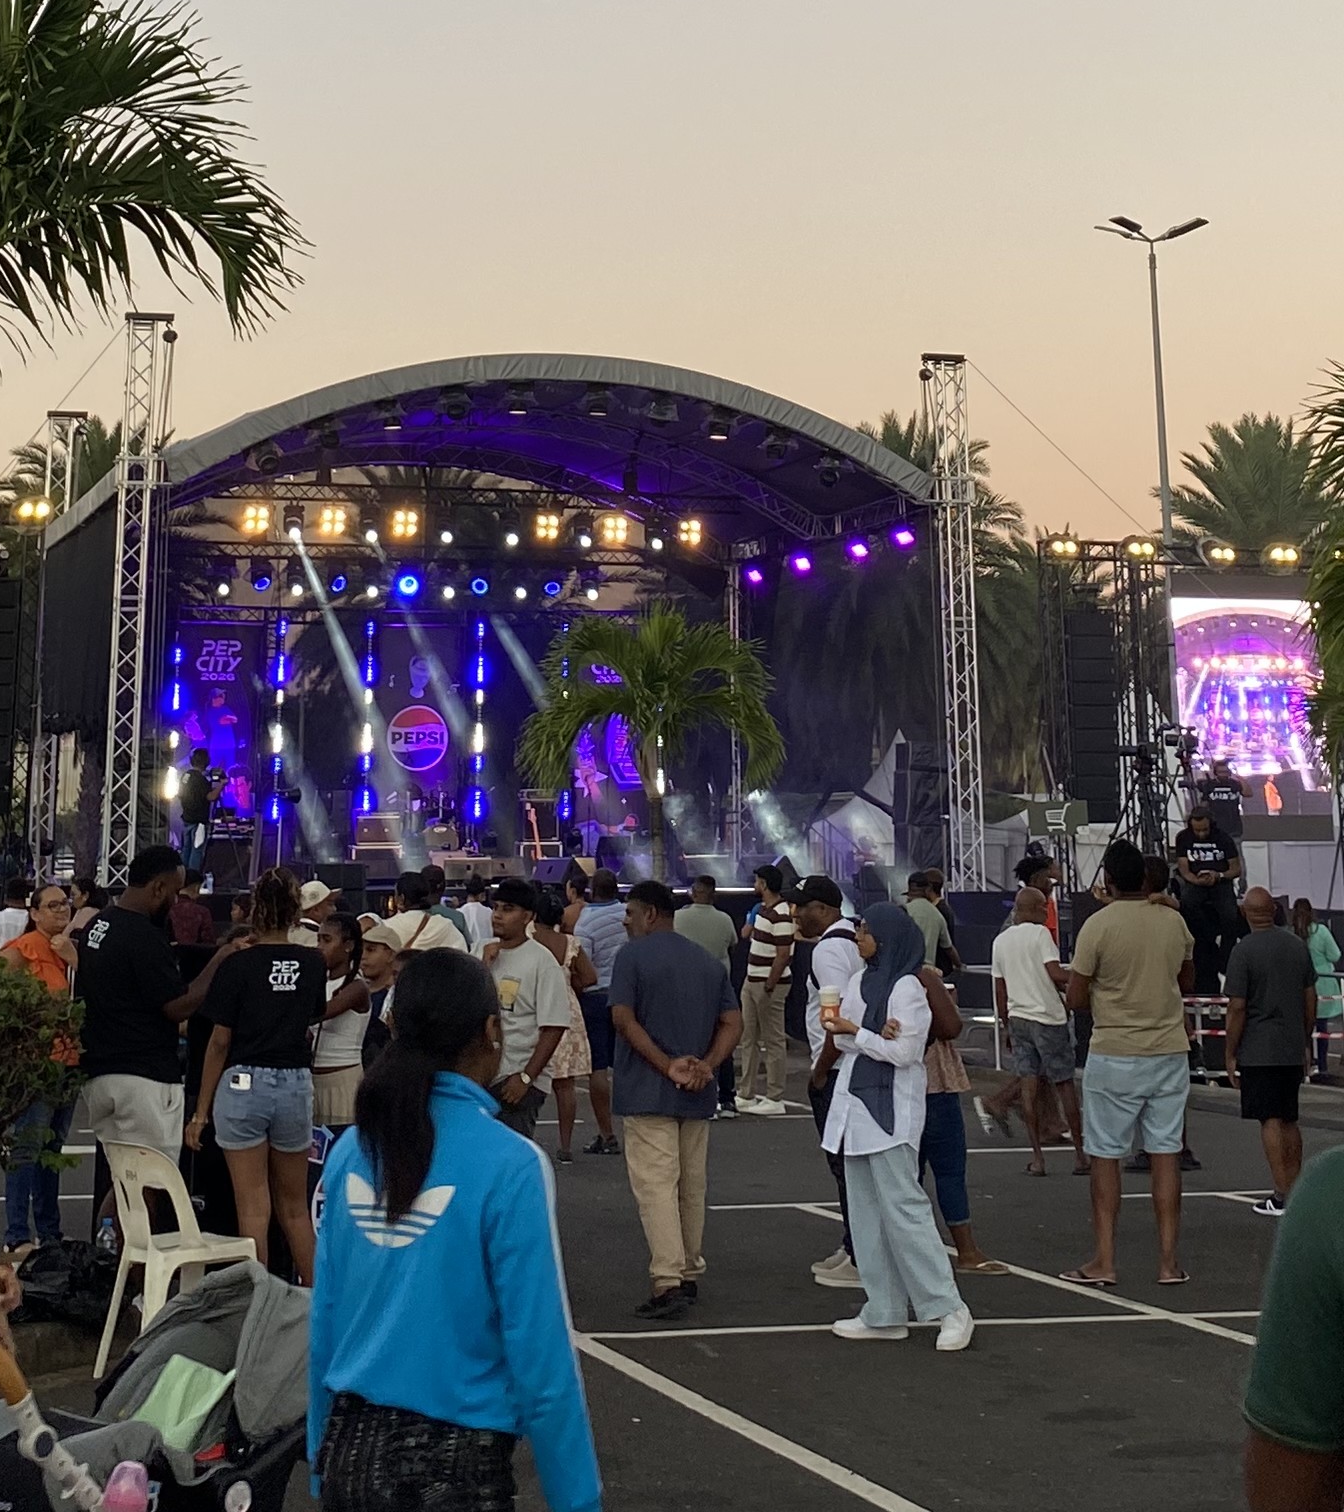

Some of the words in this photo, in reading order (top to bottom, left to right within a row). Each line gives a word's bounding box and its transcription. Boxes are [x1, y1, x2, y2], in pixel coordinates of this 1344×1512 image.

[202, 639, 242, 656] PEP
[196, 656, 242, 672] CITY
[200, 672, 235, 681] 2026
[391, 731, 444, 745] PEPSI
[272, 960, 300, 973] PEP
[268, 972, 301, 985] CITY
